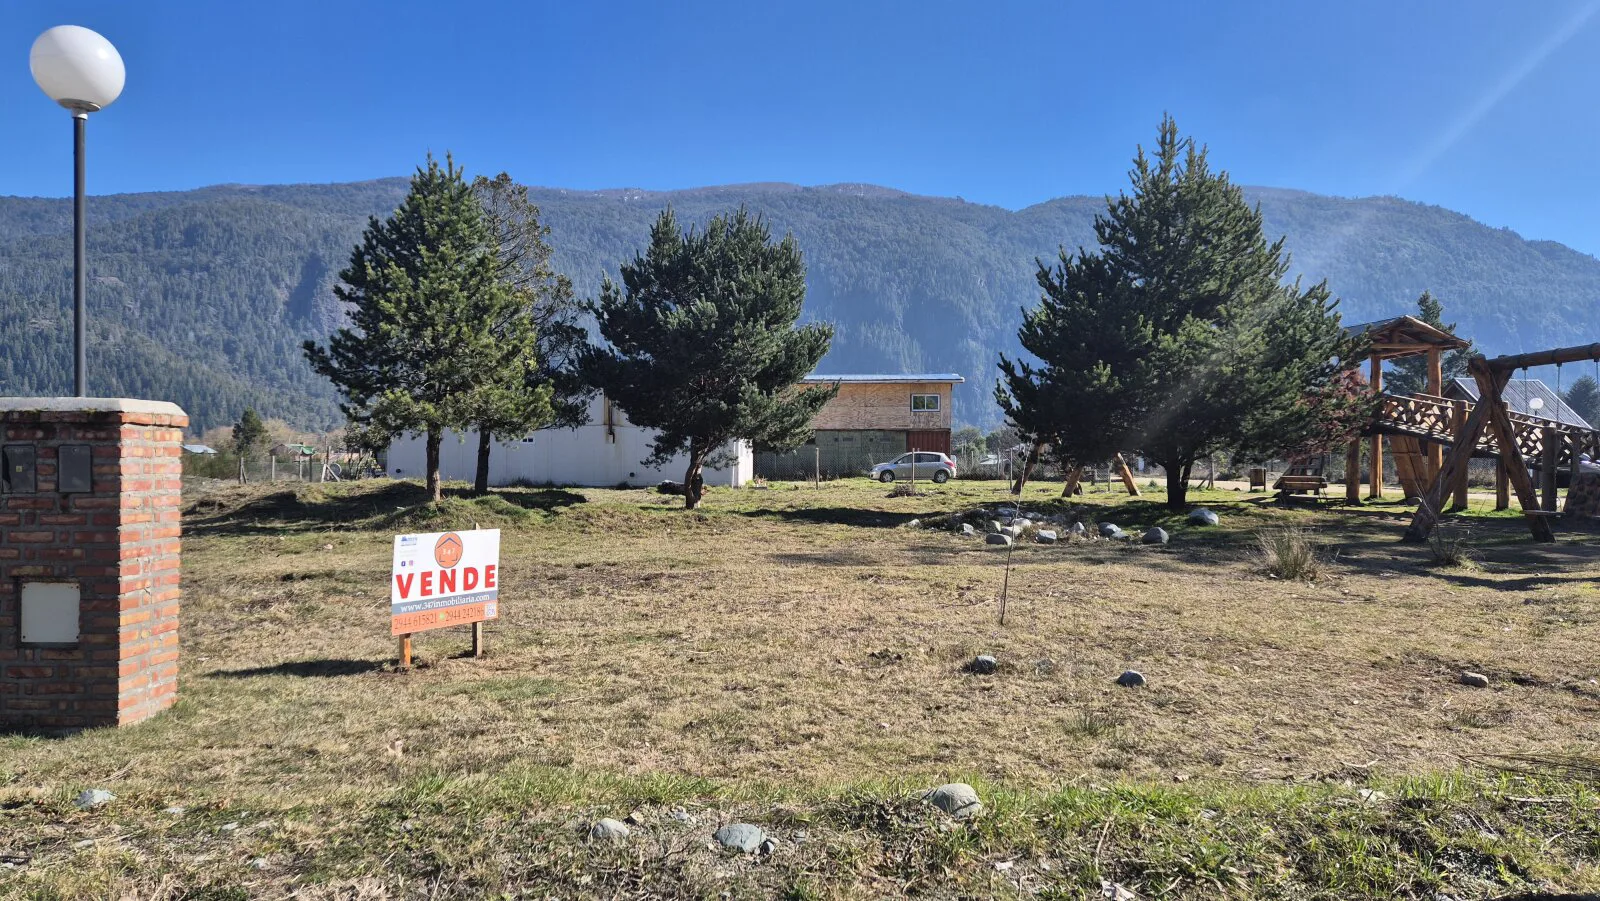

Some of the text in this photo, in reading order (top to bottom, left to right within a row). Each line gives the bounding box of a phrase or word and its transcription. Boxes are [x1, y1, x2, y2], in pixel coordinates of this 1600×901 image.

[396, 565, 495, 599] VENDE
[400, 594, 489, 613] www.347inmobiliaria.com
[394, 617, 411, 630] 2944
[445, 609, 461, 622] 2944
